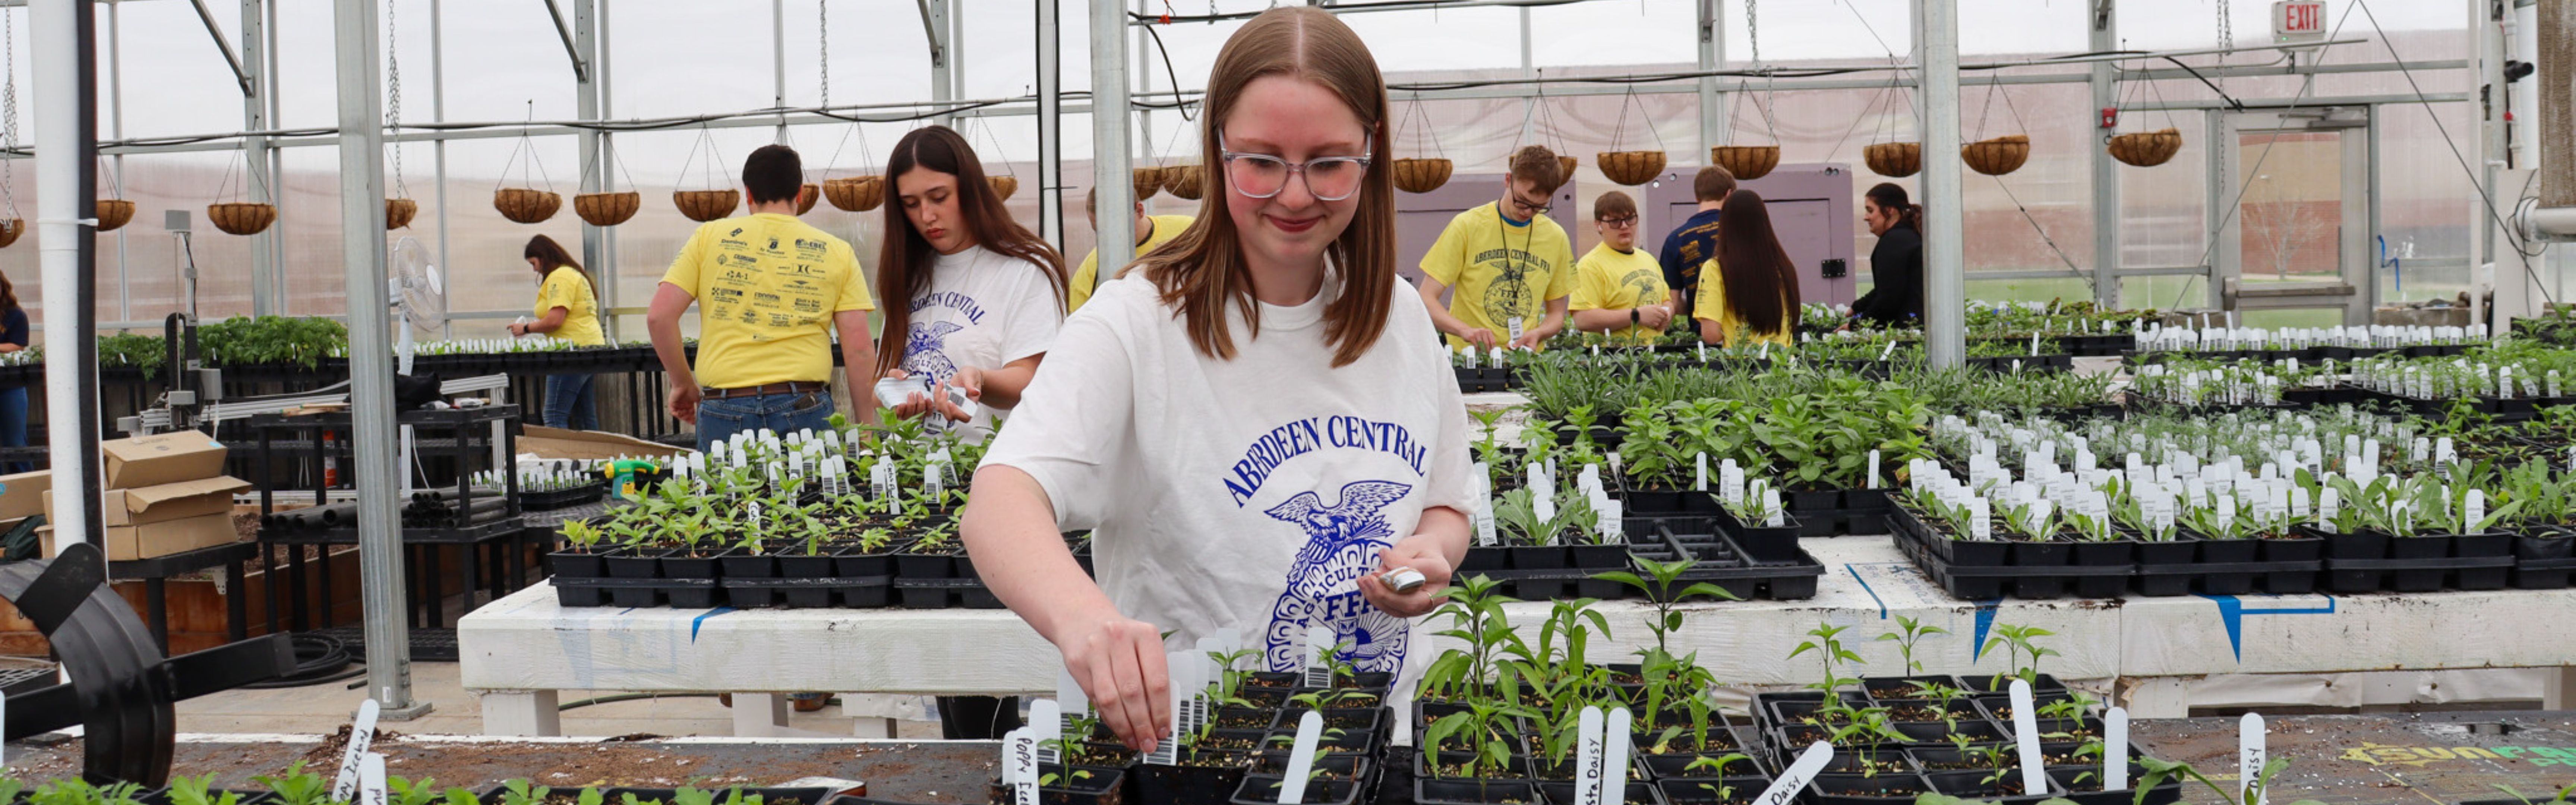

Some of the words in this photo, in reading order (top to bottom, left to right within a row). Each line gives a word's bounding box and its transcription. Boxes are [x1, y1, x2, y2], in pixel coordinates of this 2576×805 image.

[2286, 4, 2319, 30] EXIT
[1511, 249, 1538, 266] CENTRAL
[1223, 417, 1322, 508] ABERDEEN
[1328, 415, 1427, 477] CENTRAL
[1297, 567, 1378, 629] AGRICULT
[1016, 738, 1033, 773] Poppy
[1587, 738, 1600, 779] Daisy
[2248, 748, 2262, 789] Daisy
[1018, 782, 1032, 805] Icel
[1585, 779, 1598, 805] sta
[1770, 775, 1802, 805] Daisy
